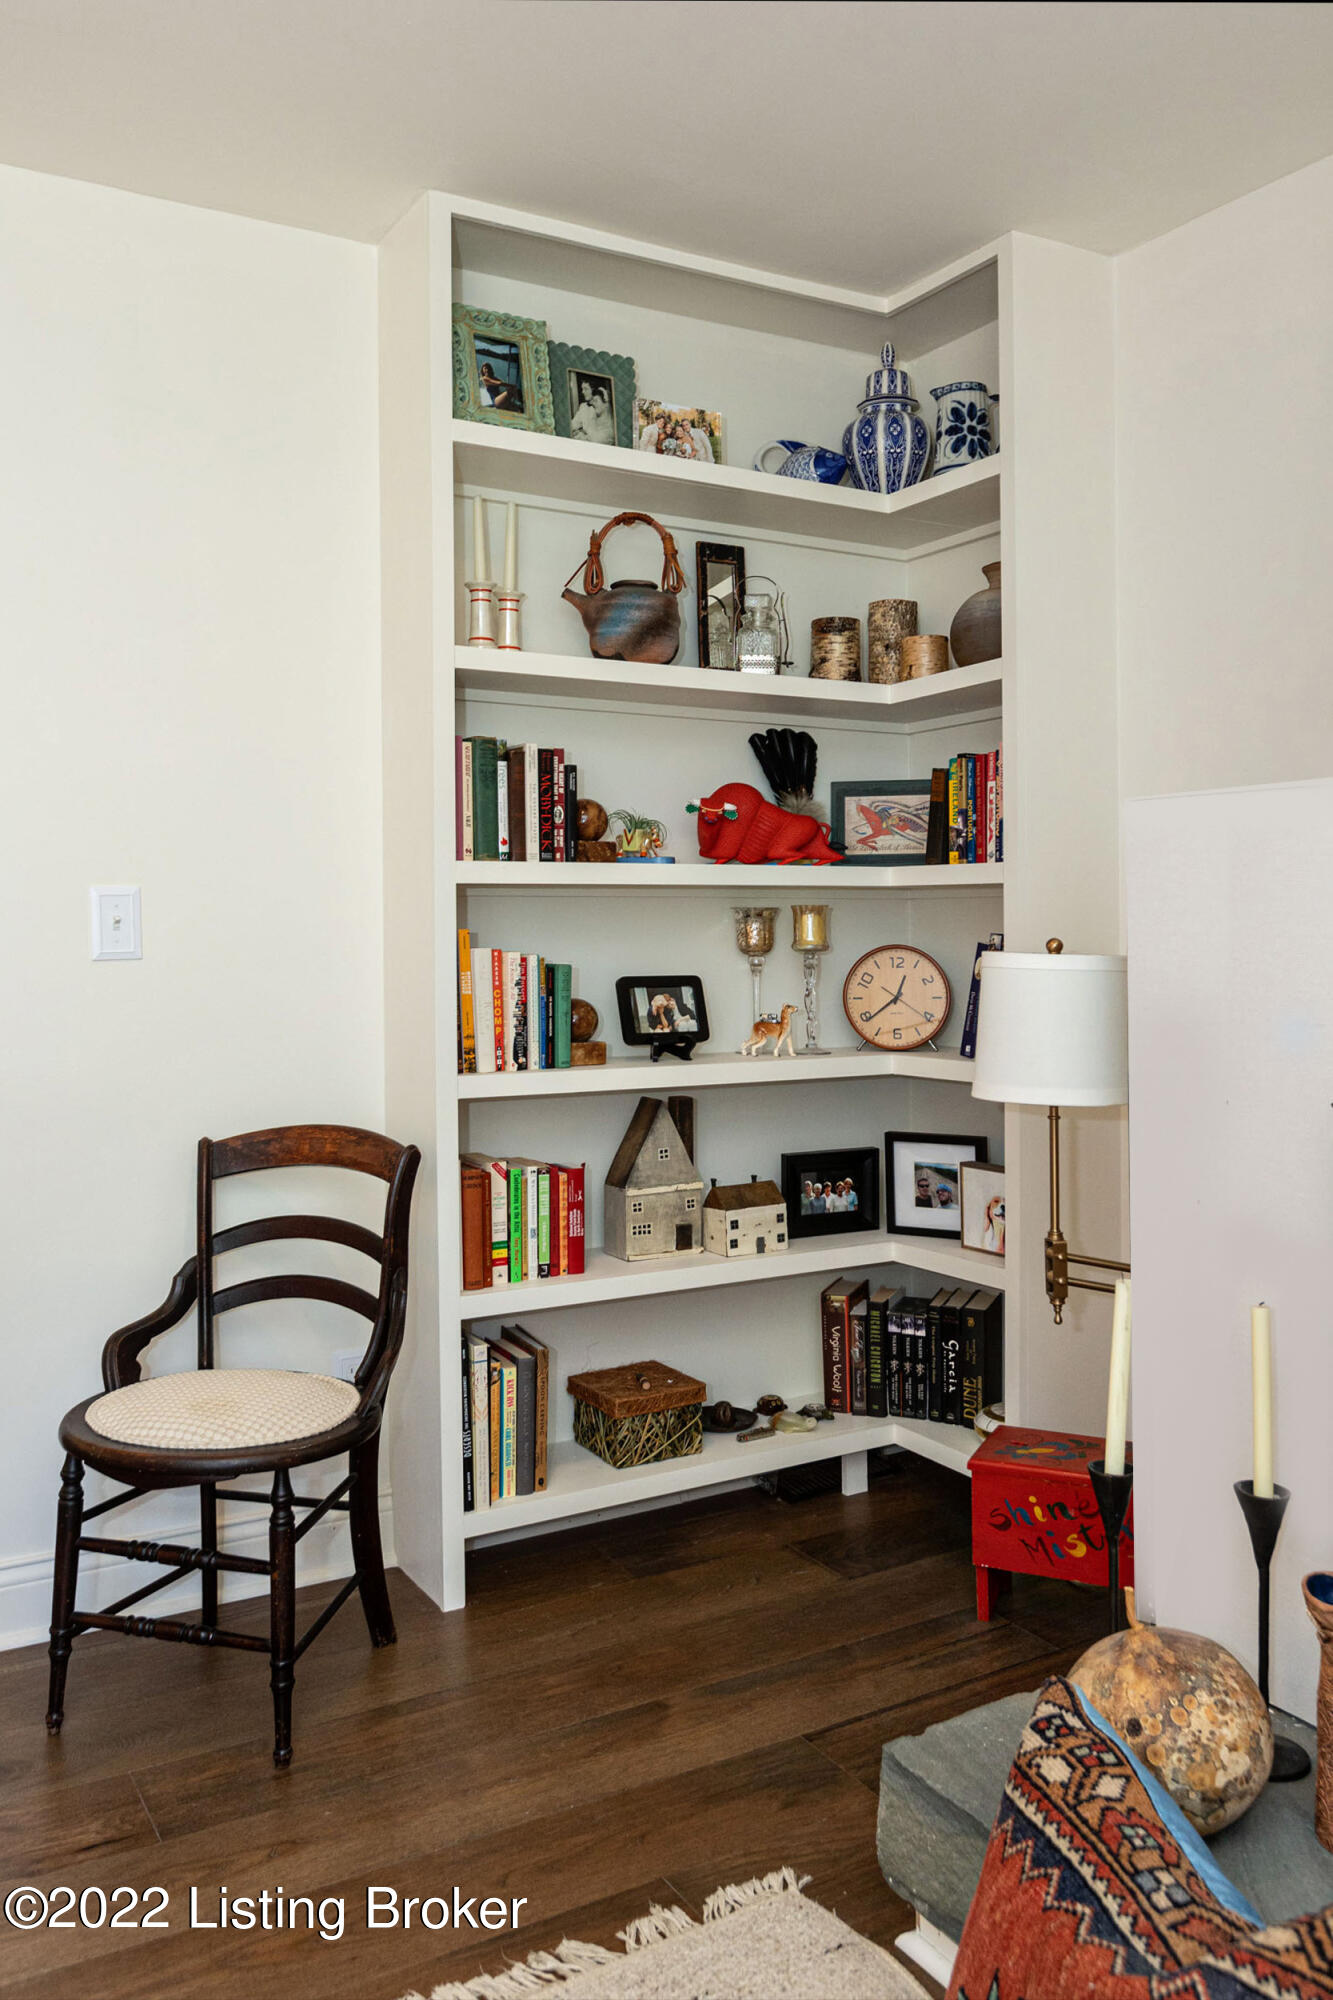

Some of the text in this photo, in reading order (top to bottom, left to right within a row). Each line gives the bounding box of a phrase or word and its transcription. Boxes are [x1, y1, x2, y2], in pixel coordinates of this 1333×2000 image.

[541, 774, 553, 851] MOBY-DICK
[889, 956, 905, 969] 12
[857, 971, 874, 989] 10
[921, 975, 935, 986] 2
[493, 989, 503, 1035] CHOMP
[860, 1010, 872, 1023] 8
[923, 1010, 936, 1023] 4
[892, 1027, 903, 1040] 6
[870, 1310, 881, 1342] MICHAEL
[829, 1325, 843, 1393] Virginia Woolf
[870, 1346, 881, 1383] CRICHTON
[942, 1339, 960, 1393] Garcia
[962, 1376, 977, 1420] DUNE
[463, 1429, 472, 1458] DESERTS
